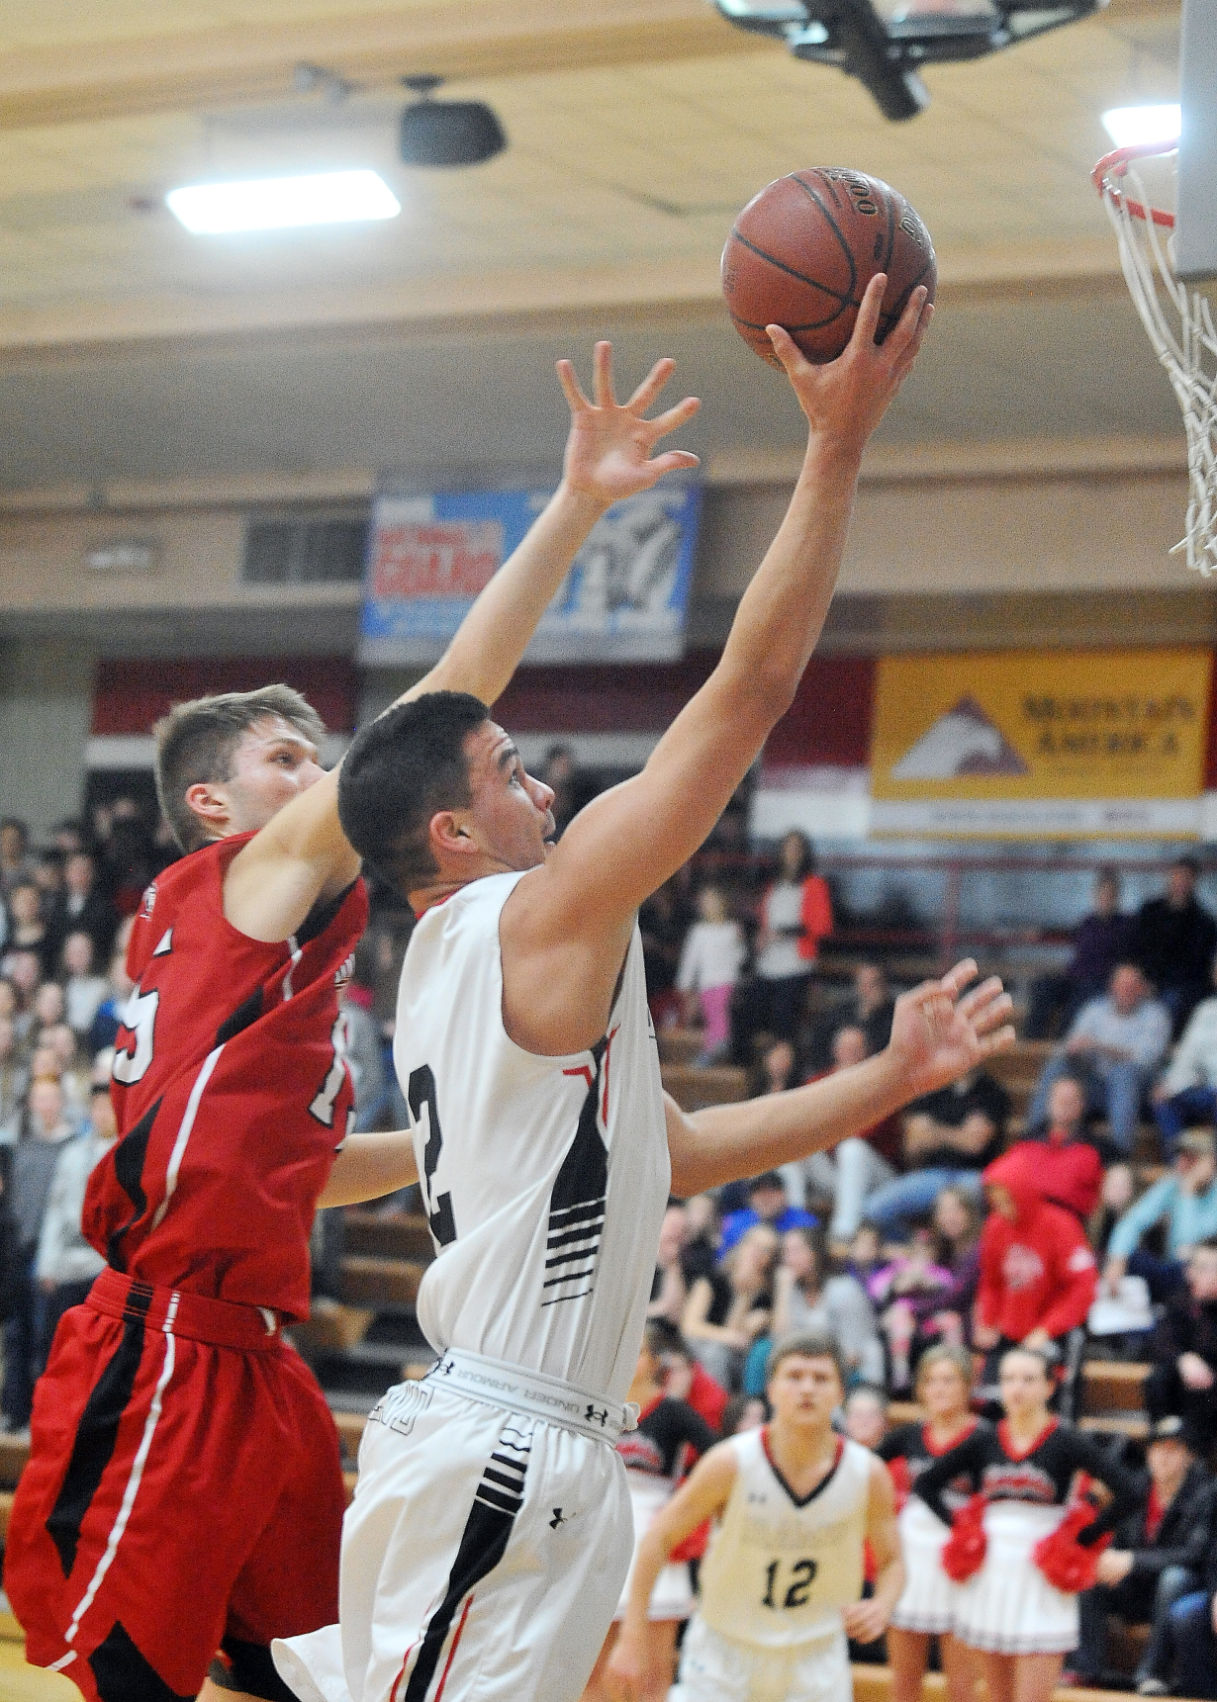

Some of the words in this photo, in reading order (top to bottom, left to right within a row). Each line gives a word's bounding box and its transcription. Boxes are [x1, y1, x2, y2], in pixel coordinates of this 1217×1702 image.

[307, 1011, 356, 1140] 1
[457, 1369, 520, 1395] ARMOUR
[523, 1389, 581, 1415] UNDER
[761, 1559, 818, 1609] 12
